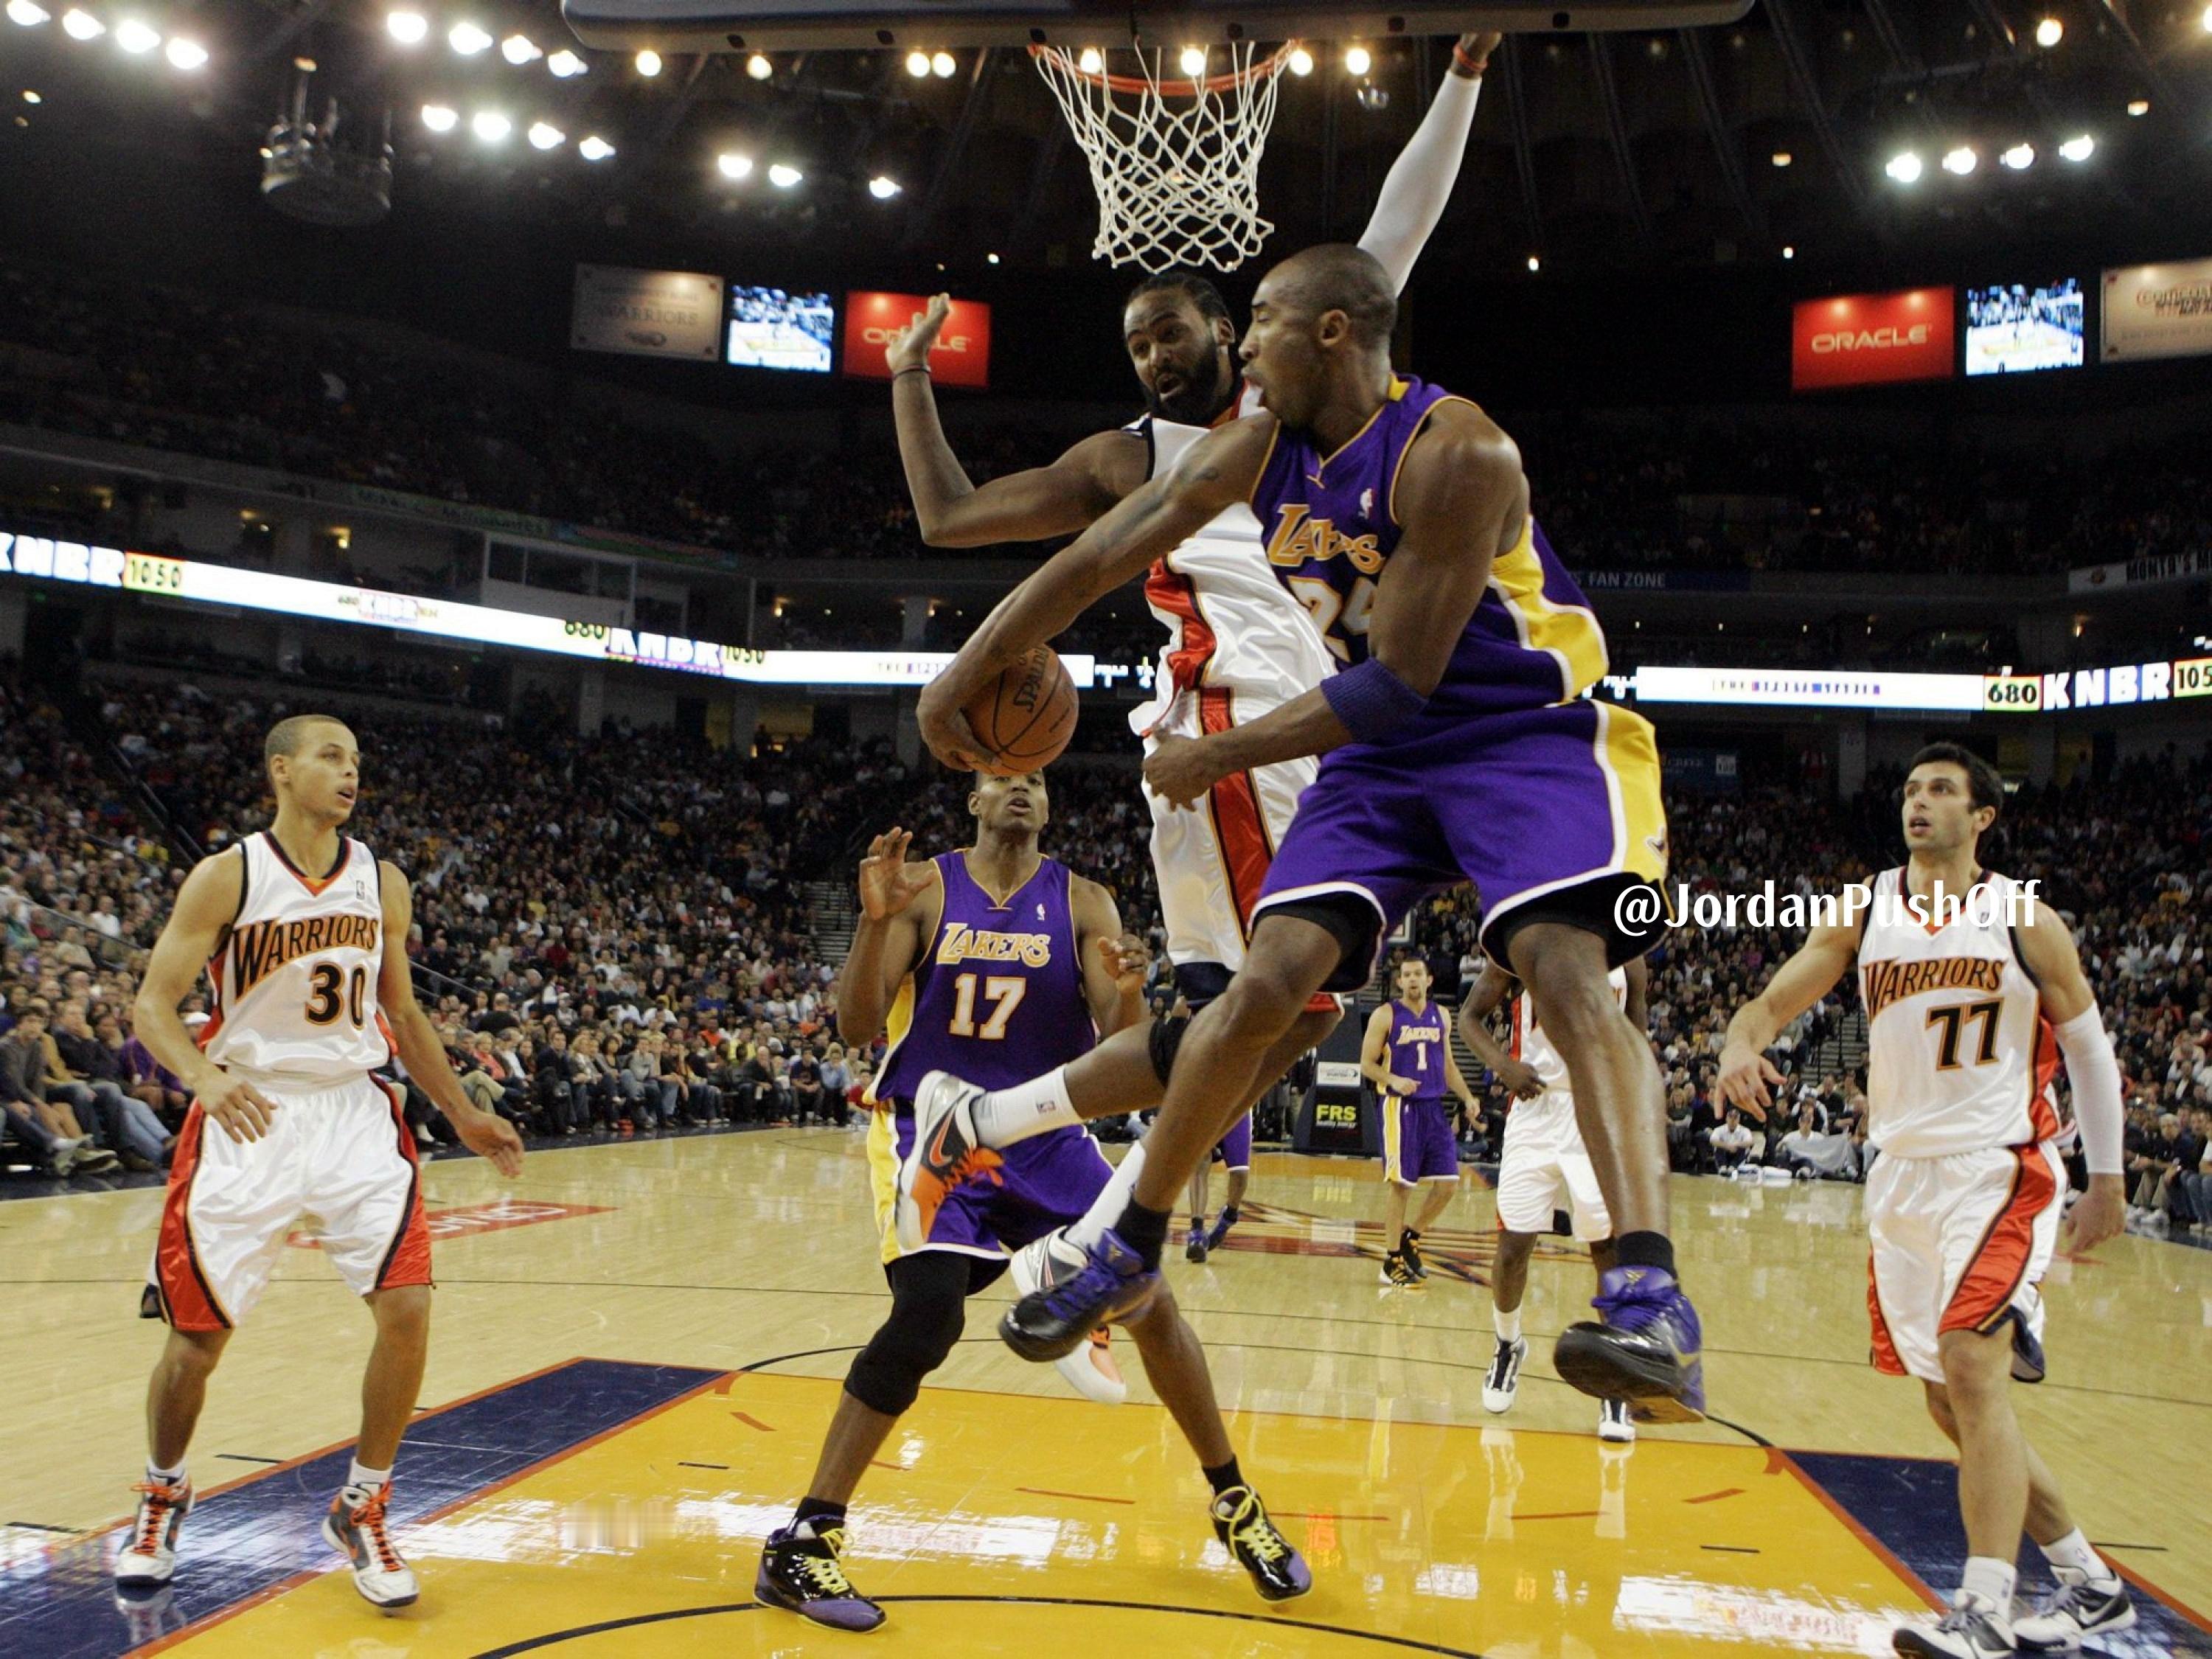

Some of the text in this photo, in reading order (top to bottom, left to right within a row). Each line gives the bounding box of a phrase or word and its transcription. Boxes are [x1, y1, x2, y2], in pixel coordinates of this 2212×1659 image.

[862, 327, 970, 353] ORLE
[1812, 324, 1927, 354] ORACLE
[130, 558, 183, 589] 1050
[1588, 572, 1619, 588] FAN
[1620, 572, 1666, 588] ZONE
[1988, 684, 2037, 703] 680
[2043, 661, 2170, 710] KNBR
[233, 914, 378, 1004] WARRIORS
[936, 922, 1051, 967] LAKERS
[305, 961, 366, 1030] 30
[949, 973, 1026, 1040] 17
[1861, 956, 2009, 1027] WARRIORS
[1396, 1025, 1440, 1045] LAKERS
[1924, 997, 2004, 1071] 77
[1417, 1043, 1427, 1070] 1
[1315, 1105, 1357, 1121] FRS
